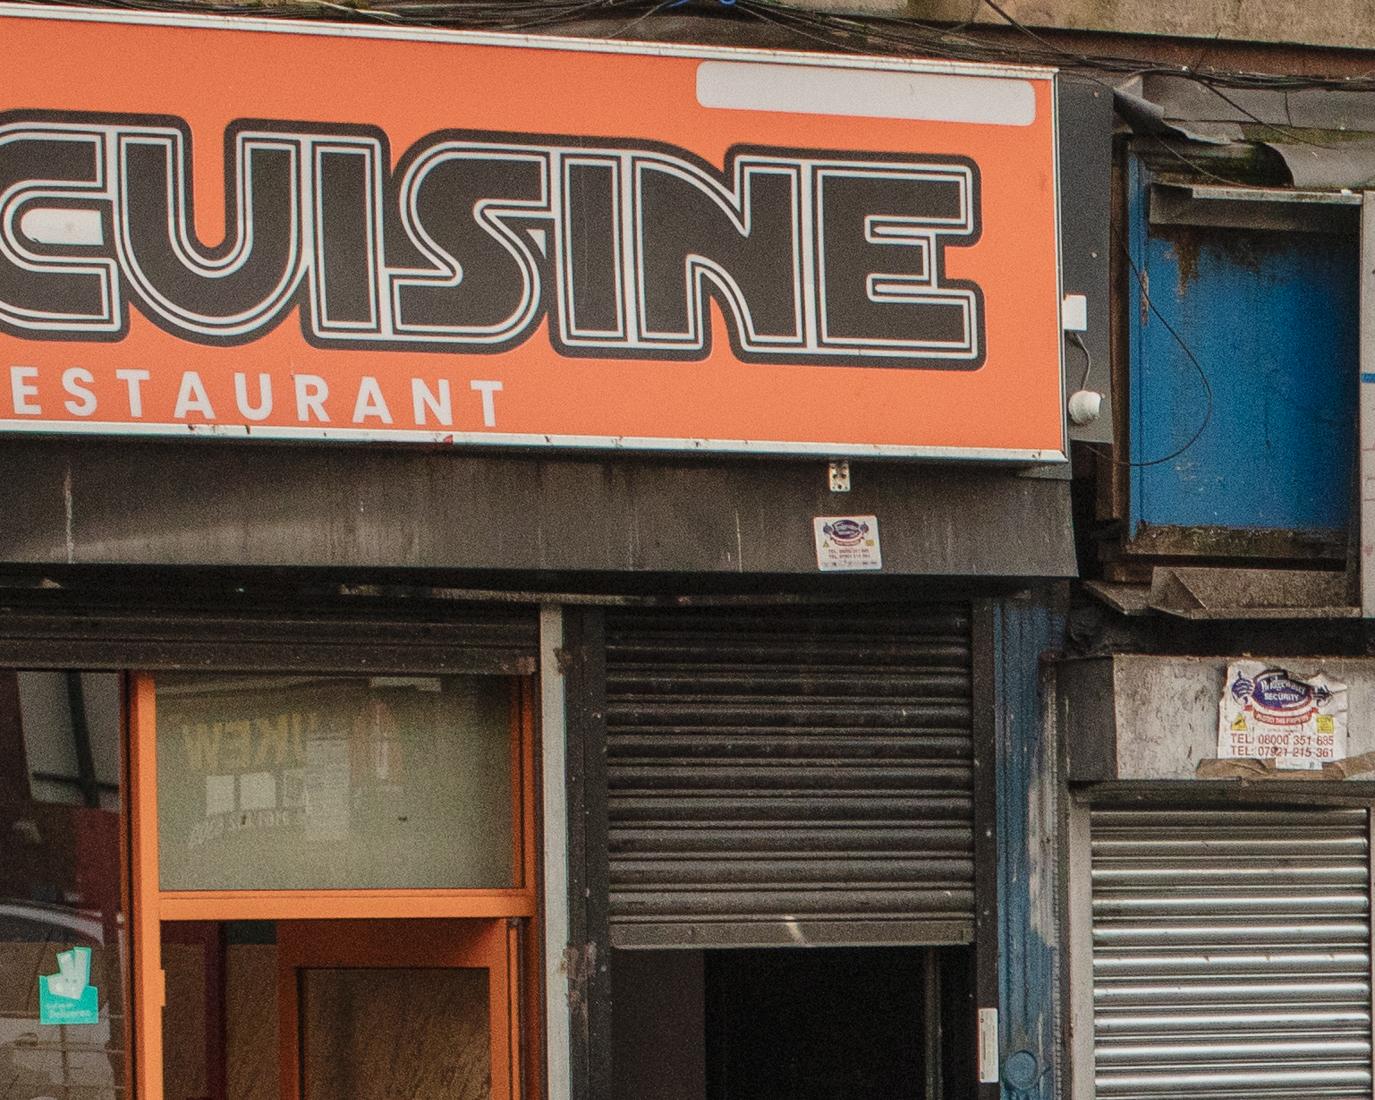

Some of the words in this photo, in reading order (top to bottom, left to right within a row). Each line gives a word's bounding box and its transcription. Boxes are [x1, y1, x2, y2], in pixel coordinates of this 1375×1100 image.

[0, 110, 986, 371] CUISINE
[1264, 692, 1300, 701] SECURITY
[1258, 734, 1289, 745] 08000
[1293, 735, 1312, 745] 351
[1292, 747, 1312, 757] 215
[1316, 748, 1334, 757] 361
